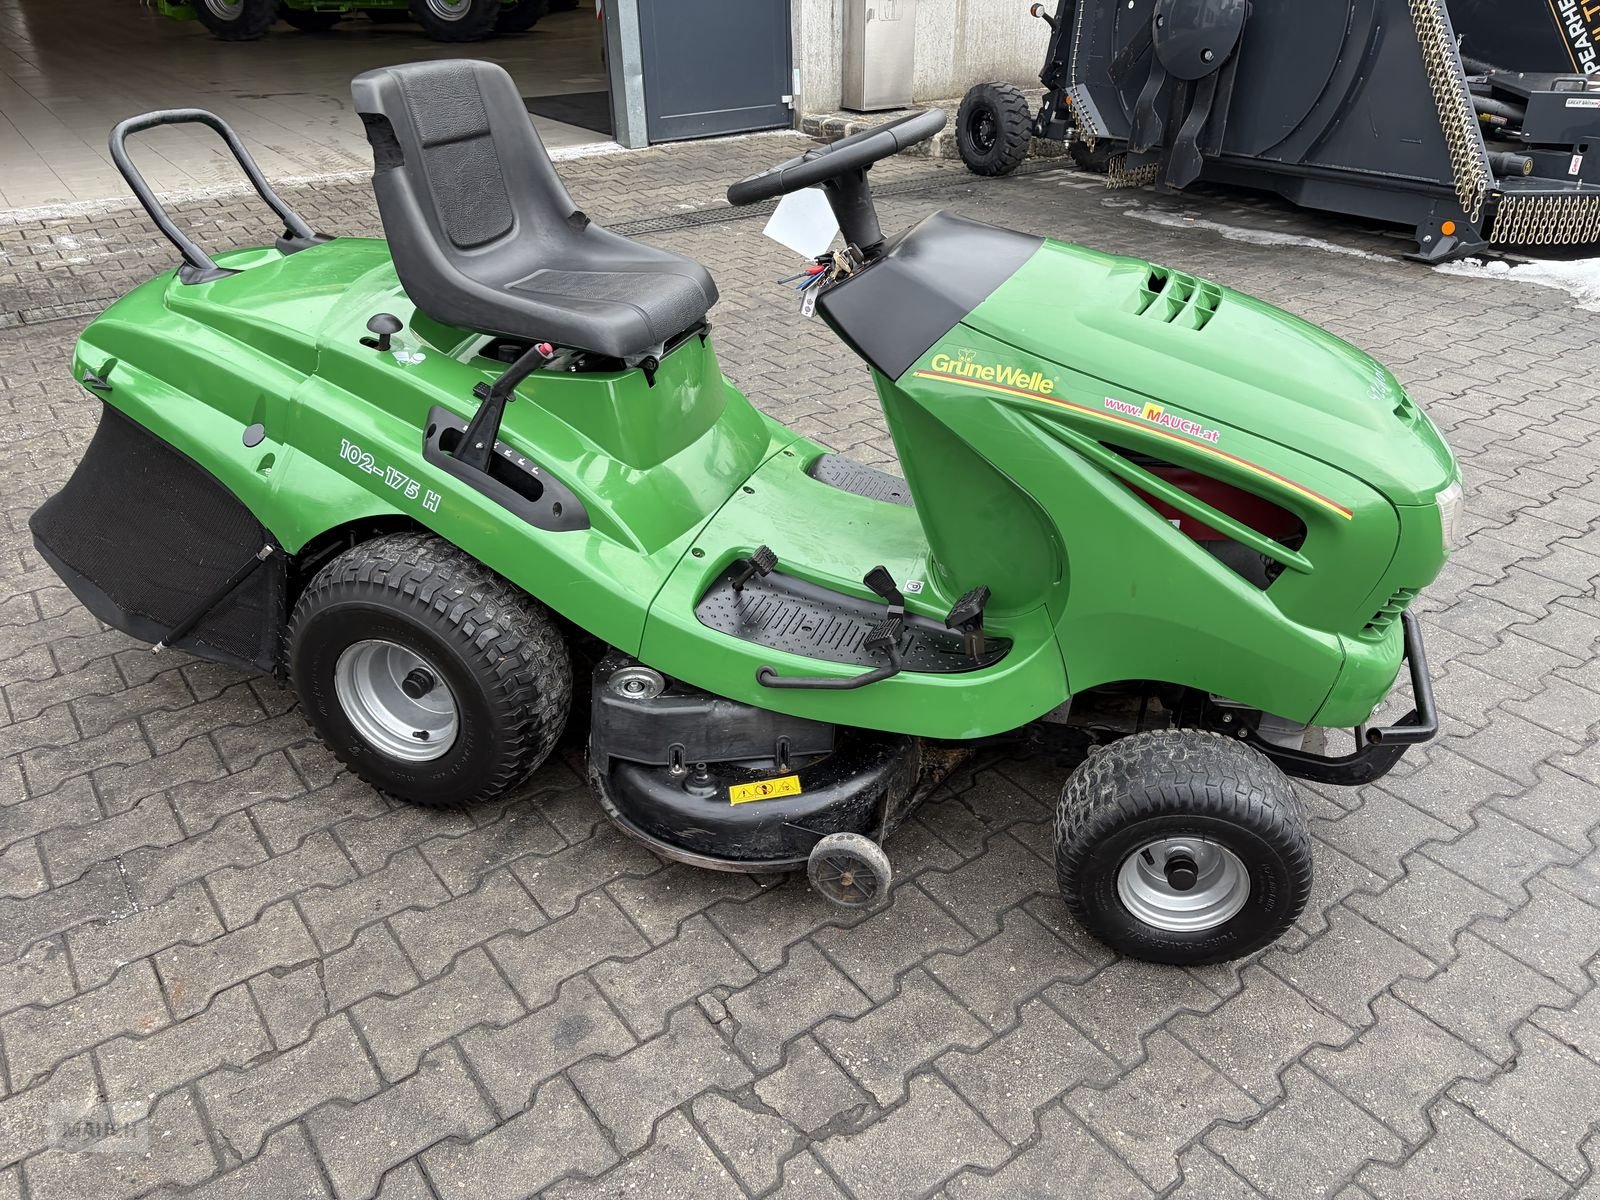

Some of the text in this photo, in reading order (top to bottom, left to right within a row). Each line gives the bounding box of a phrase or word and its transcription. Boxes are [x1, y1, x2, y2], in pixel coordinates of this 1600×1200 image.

[1557, 0, 1600, 75] PEARHE
[340, 438, 442, 512] 102-175 H
